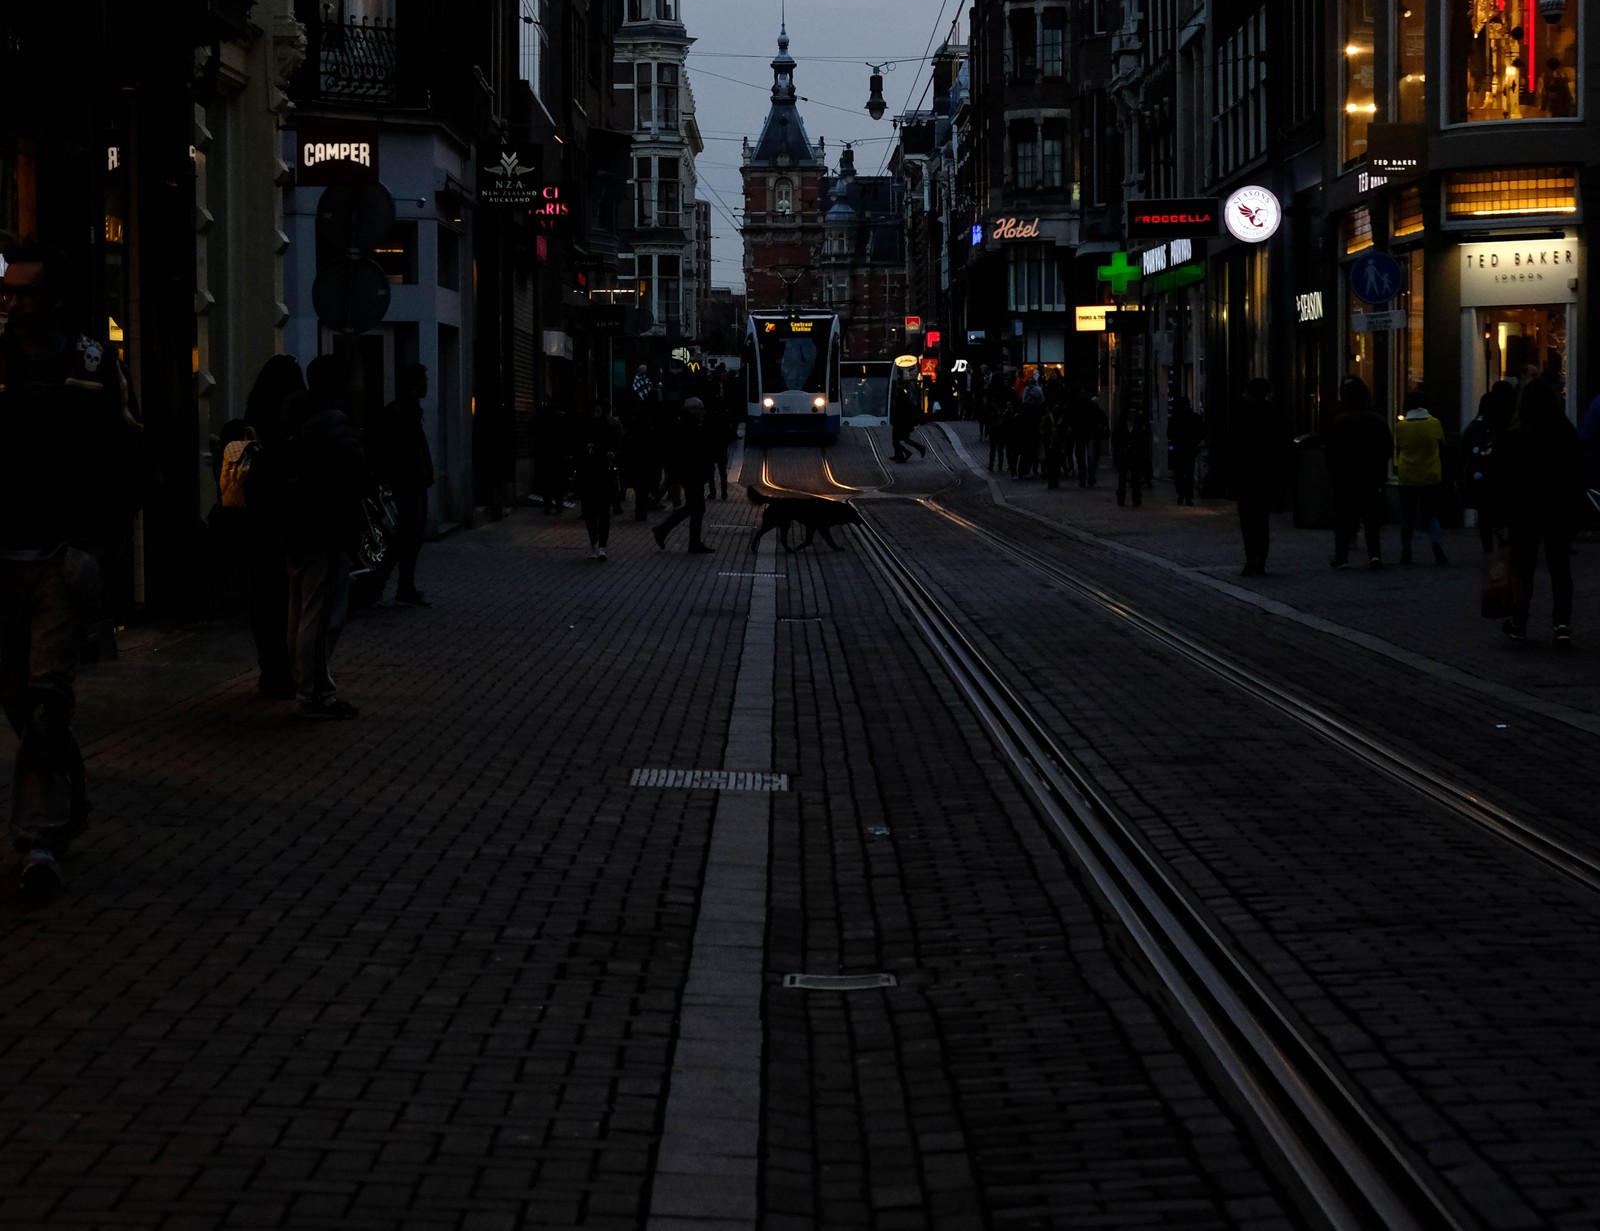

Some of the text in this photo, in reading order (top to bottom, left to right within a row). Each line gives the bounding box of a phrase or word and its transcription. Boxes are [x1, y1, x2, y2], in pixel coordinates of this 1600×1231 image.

[304, 143, 370, 167] CAMPER
[993, 217, 1040, 239] Hotel
[1467, 250, 1572, 268] TED BAKER
[1495, 273, 1543, 283] LONDON
[951, 359, 968, 372] JD
